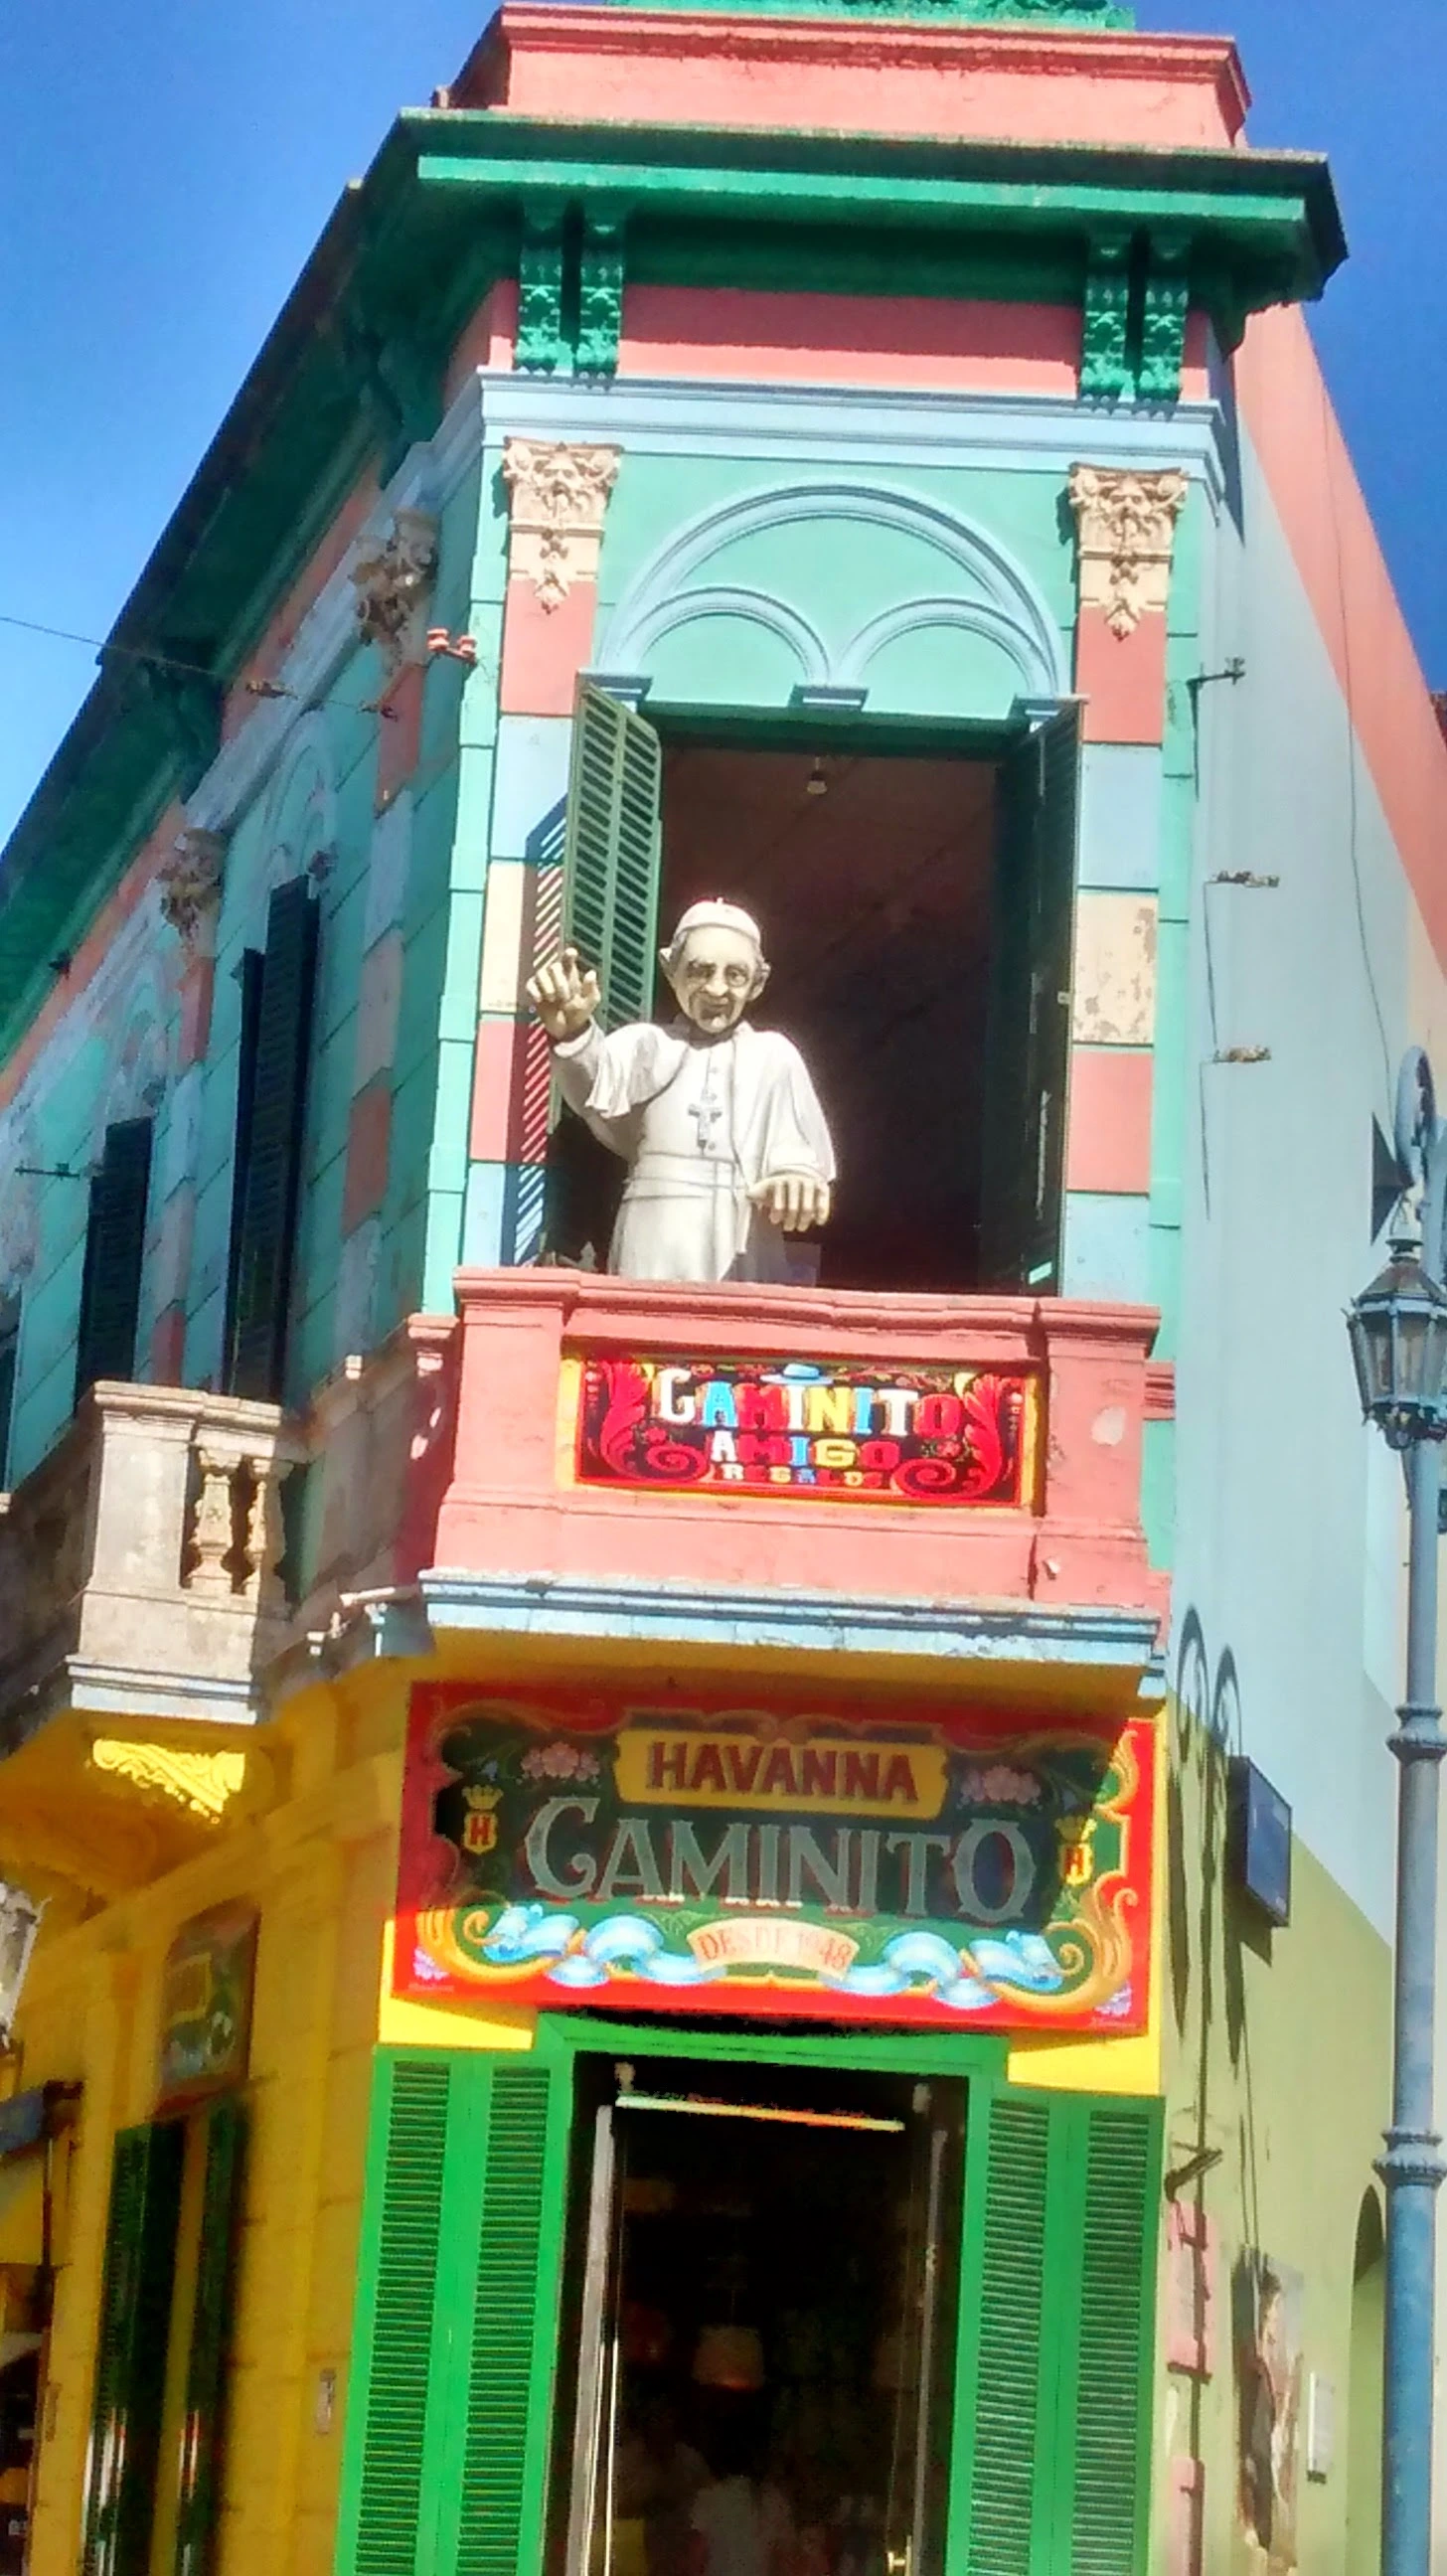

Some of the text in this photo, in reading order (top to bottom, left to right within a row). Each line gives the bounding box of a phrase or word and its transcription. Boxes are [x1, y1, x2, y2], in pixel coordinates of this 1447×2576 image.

[656, 1368, 962, 1436] CAMINITO
[711, 1430, 899, 1470] AMIGO
[719, 1463, 883, 1488] REGALOS
[651, 1741, 918, 1802] HAVANNA
[470, 1816, 491, 1846] H
[525, 1797, 1036, 1921] CAMINITO
[698, 1925, 789, 1961] DESDE
